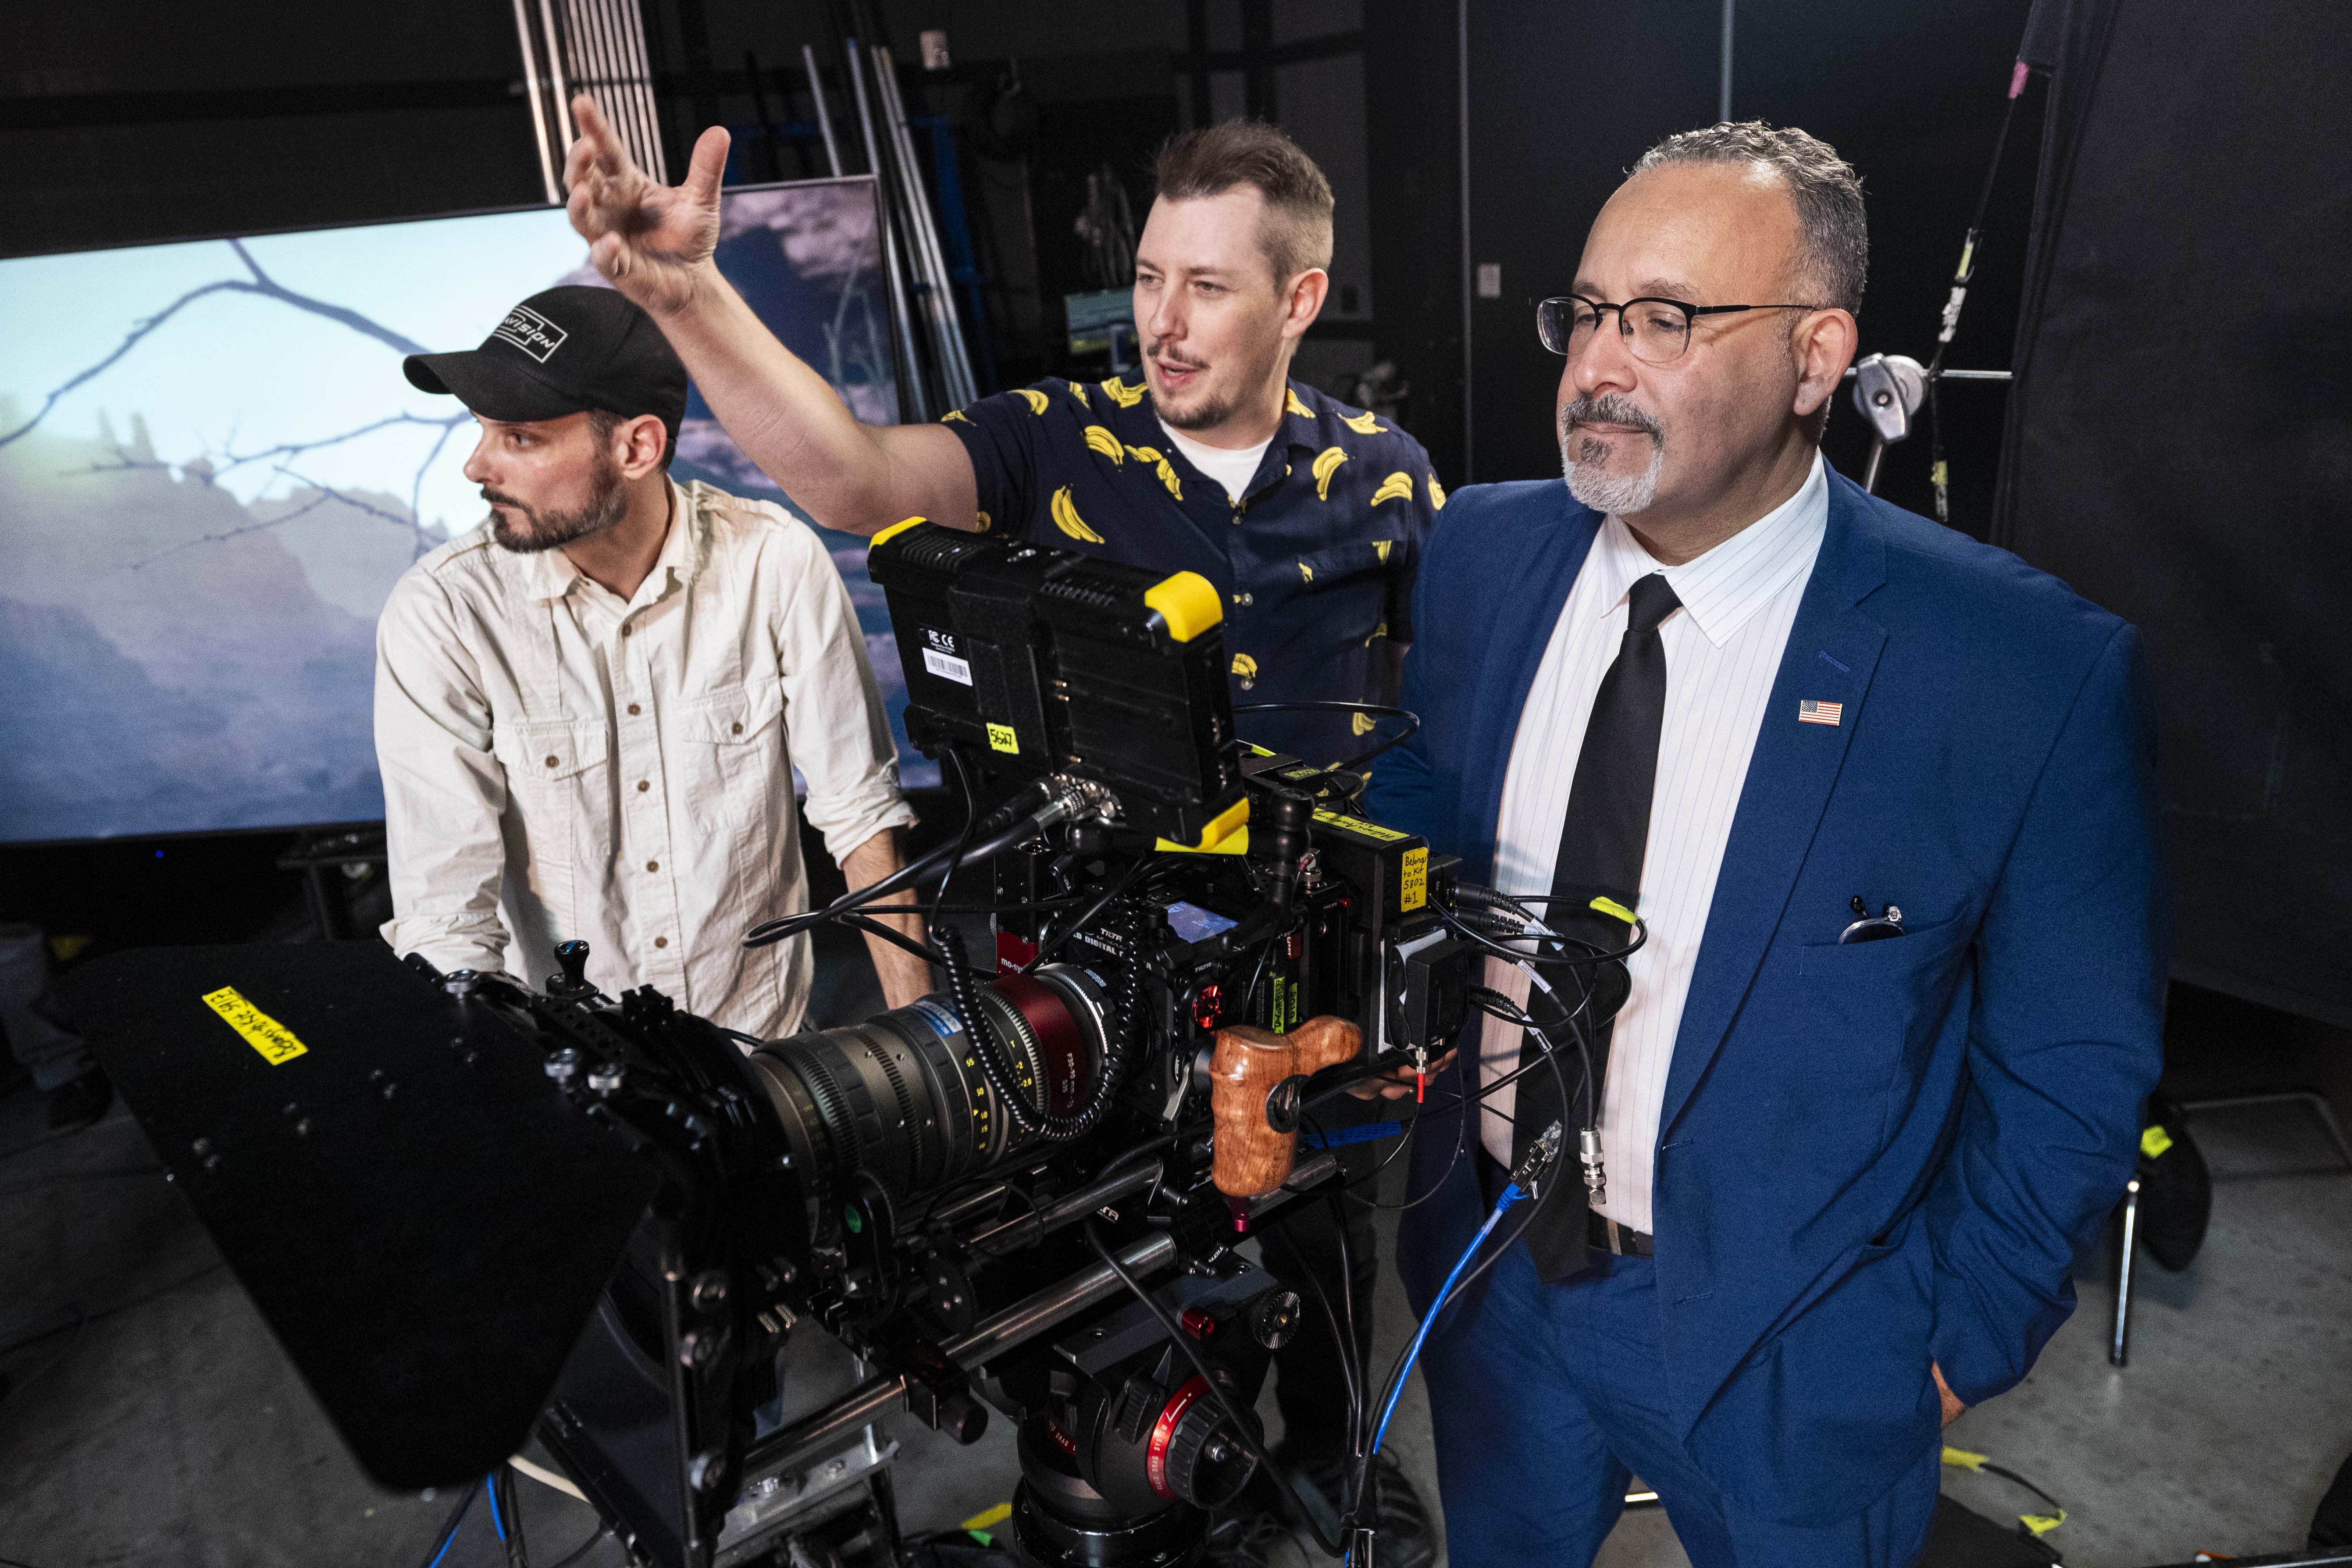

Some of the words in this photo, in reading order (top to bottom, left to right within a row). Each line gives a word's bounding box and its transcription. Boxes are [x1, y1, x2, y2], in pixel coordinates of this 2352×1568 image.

[990, 727, 1012, 747] 5627
[1405, 854, 1427, 867] Belongs
[1404, 870, 1411, 878] to
[1413, 867, 1424, 877] Kit
[1404, 878, 1425, 890] 5802
[1404, 891, 1418, 904] #1
[1085, 936, 1116, 955] DIGITAL
[1055, 1432, 1069, 1447] DRAG
